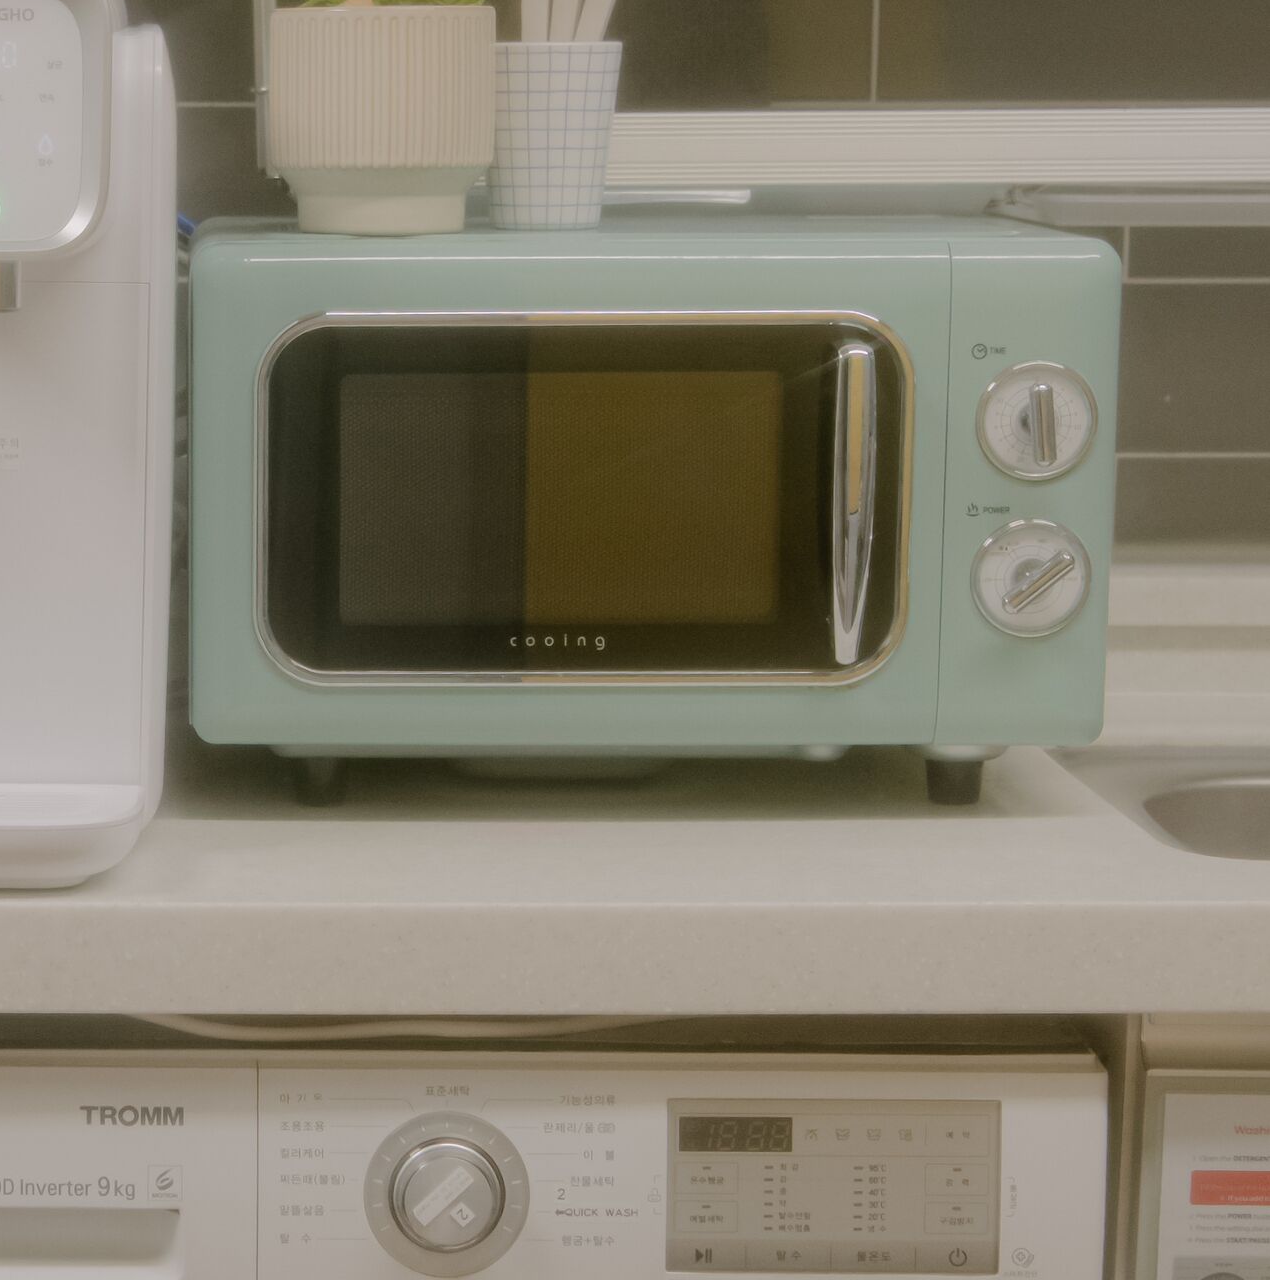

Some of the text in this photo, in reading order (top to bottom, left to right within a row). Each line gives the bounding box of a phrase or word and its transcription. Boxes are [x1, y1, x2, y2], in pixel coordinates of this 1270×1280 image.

[988, 347, 1006, 355] TIME
[982, 506, 1010, 514] POWER
[510, 633, 606, 651] cooing
[425, 1085, 470, 1097] 표준세탁
[559, 1095, 617, 1107] 기능성의류
[80, 1104, 185, 1127] TROMM
[280, 1121, 325, 1133] 조용조용
[280, 1148, 325, 1160] 컬러케어
[19, 1176, 92, 1197] Inverter
[570, 1175, 615, 1188] 찬물세탁
[557, 1188, 566, 1201] 2
[279, 1204, 325, 1217] 알뜰삶음
[456, 1208, 469, 1221] 2
[564, 1207, 639, 1218] QUICK WASH
[562, 1234, 616, 1248] 헹굼+탈수
